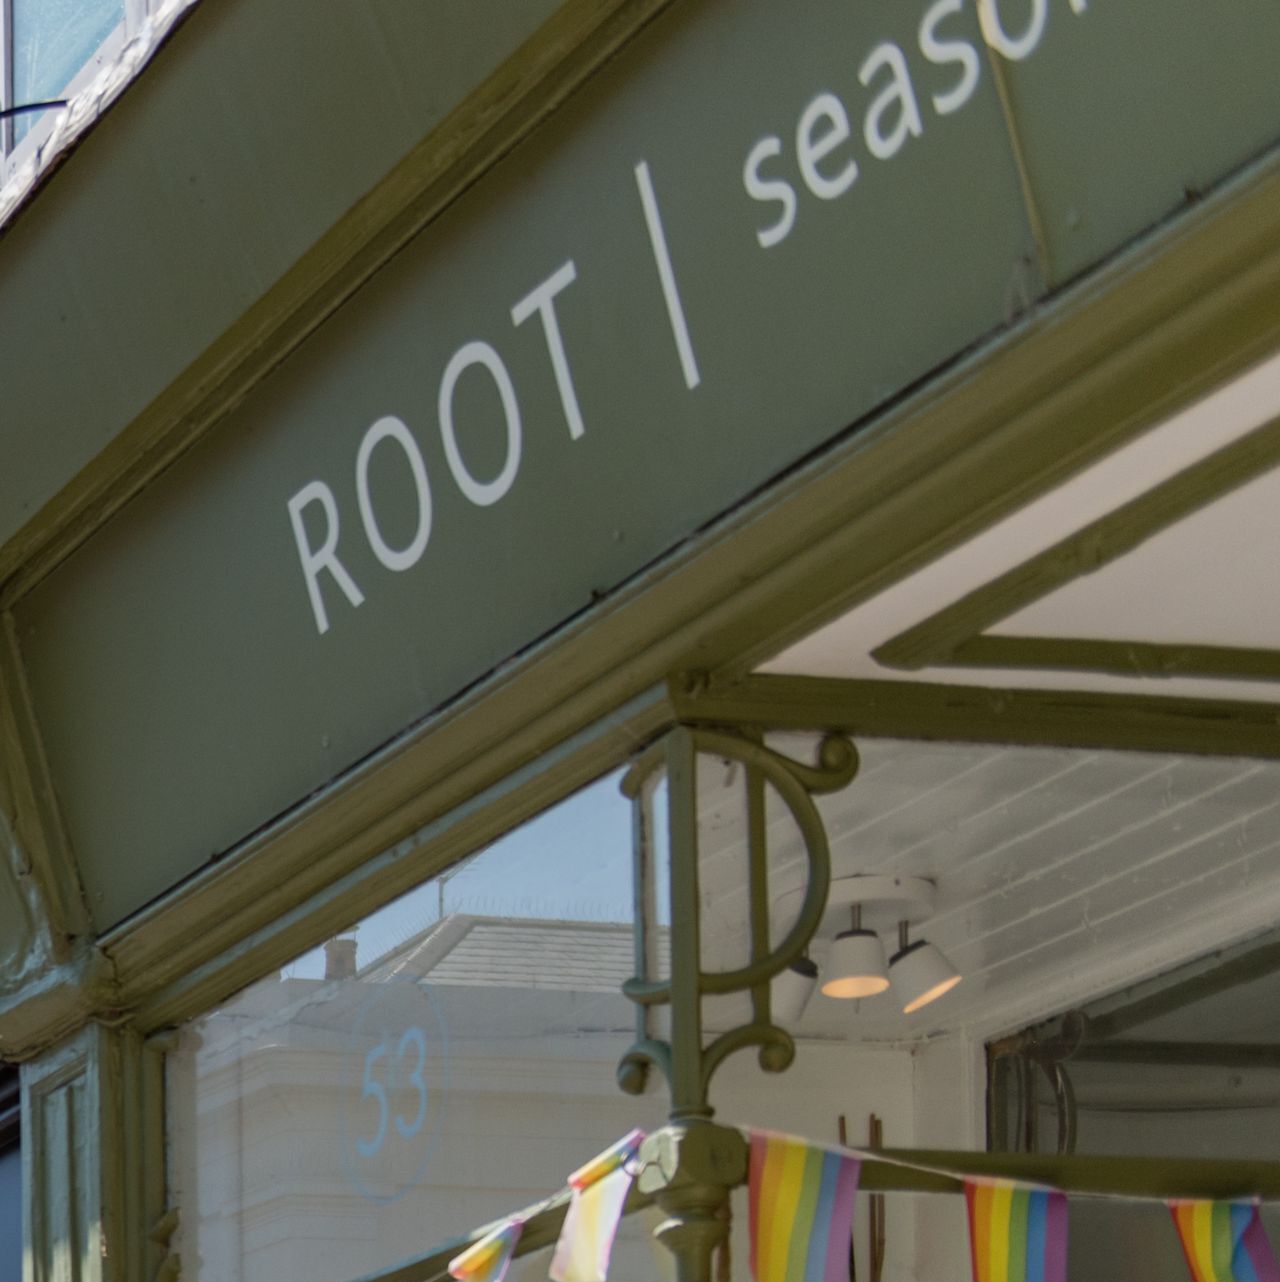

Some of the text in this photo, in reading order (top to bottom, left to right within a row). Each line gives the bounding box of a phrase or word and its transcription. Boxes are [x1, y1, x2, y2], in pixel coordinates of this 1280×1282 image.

[287, 260, 585, 635] ROOT
[741, 0, 1090, 248] seaso
[355, 1026, 428, 1158] 53
